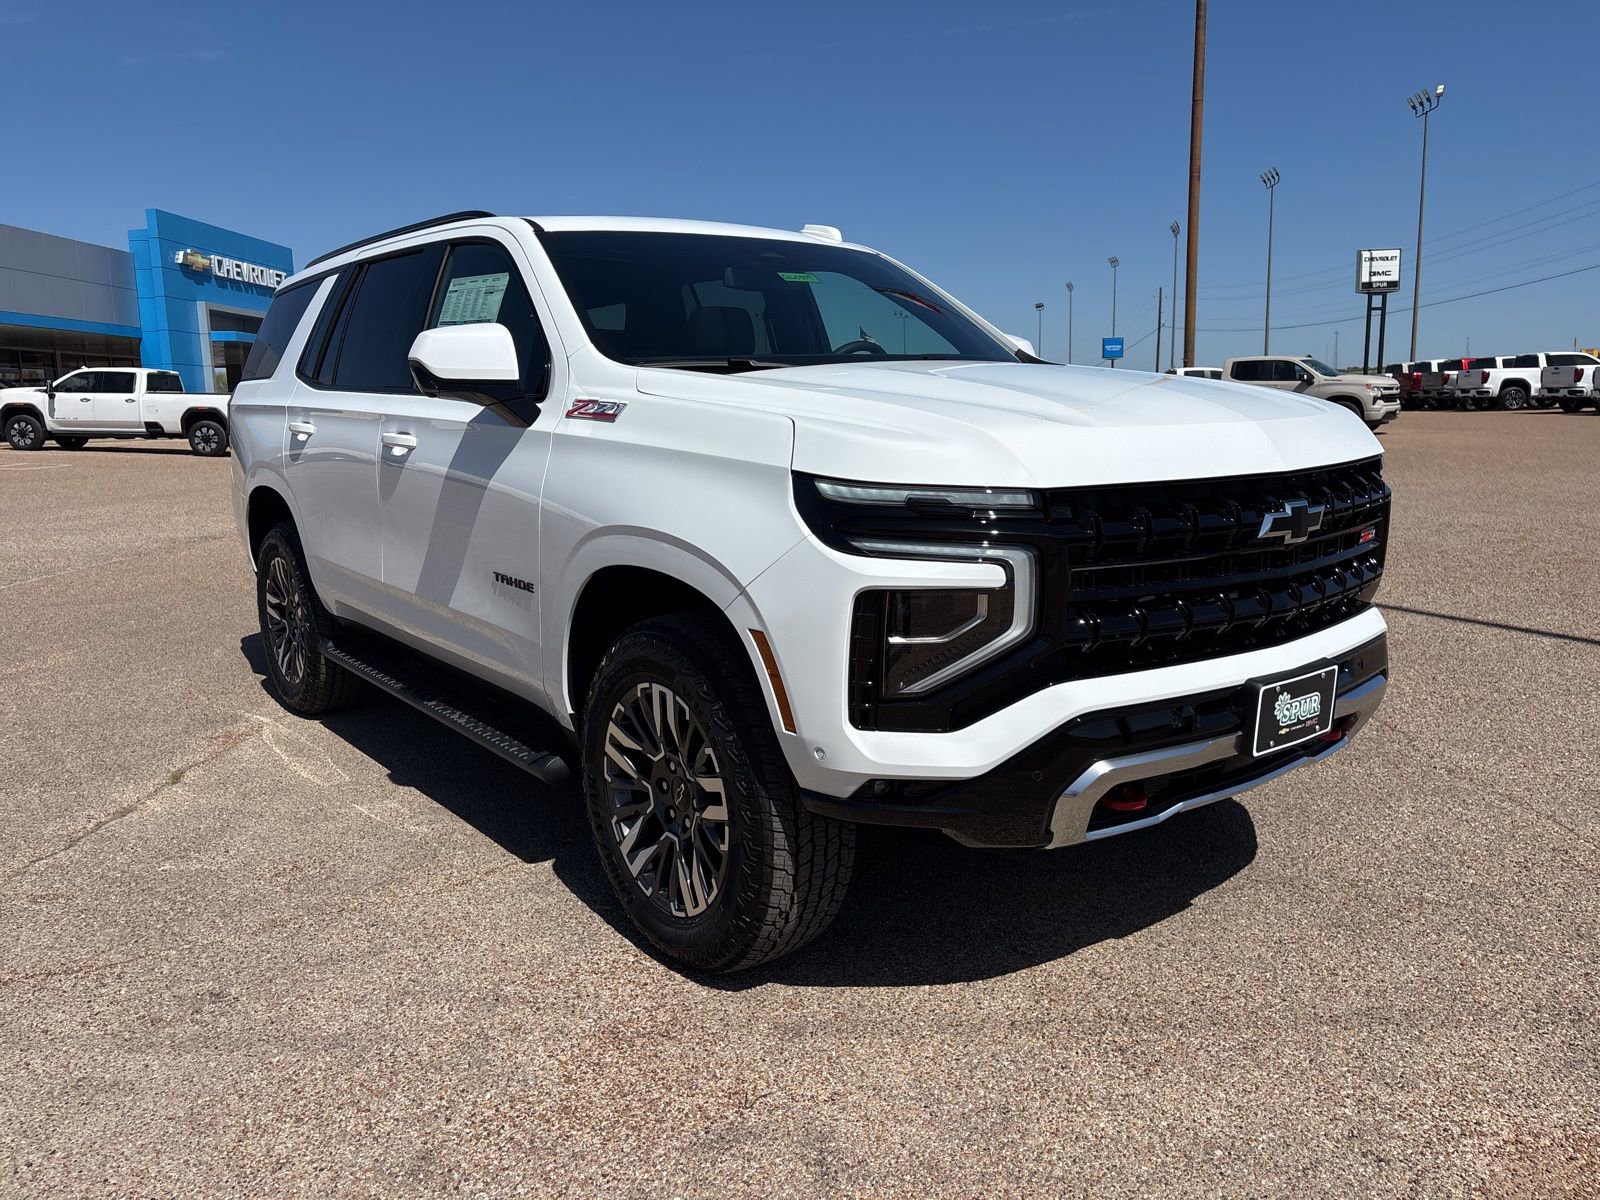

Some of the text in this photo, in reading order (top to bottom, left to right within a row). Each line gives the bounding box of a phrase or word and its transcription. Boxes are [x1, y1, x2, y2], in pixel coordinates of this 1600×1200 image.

[211, 255, 287, 288] CHEVROLET
[565, 399, 627, 423] Z71
[493, 571, 535, 593] TAHOE
[1281, 695, 1320, 724] SPUR
